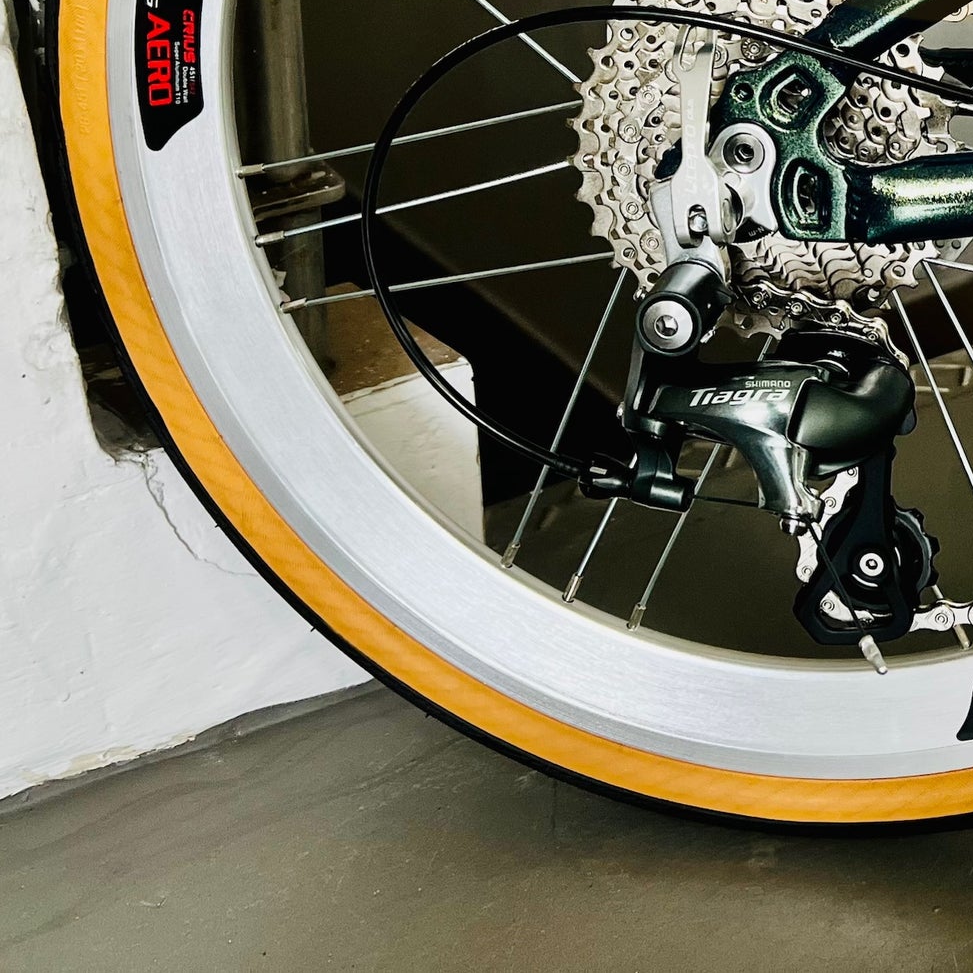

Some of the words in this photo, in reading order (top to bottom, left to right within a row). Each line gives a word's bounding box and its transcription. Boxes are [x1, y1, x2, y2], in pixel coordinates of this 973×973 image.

[182, 8, 196, 64] CRIUS
[146, 11, 173, 107] AERO
[688, 386, 790, 408] Tiagra
[744, 379, 792, 389] SHIMANO
